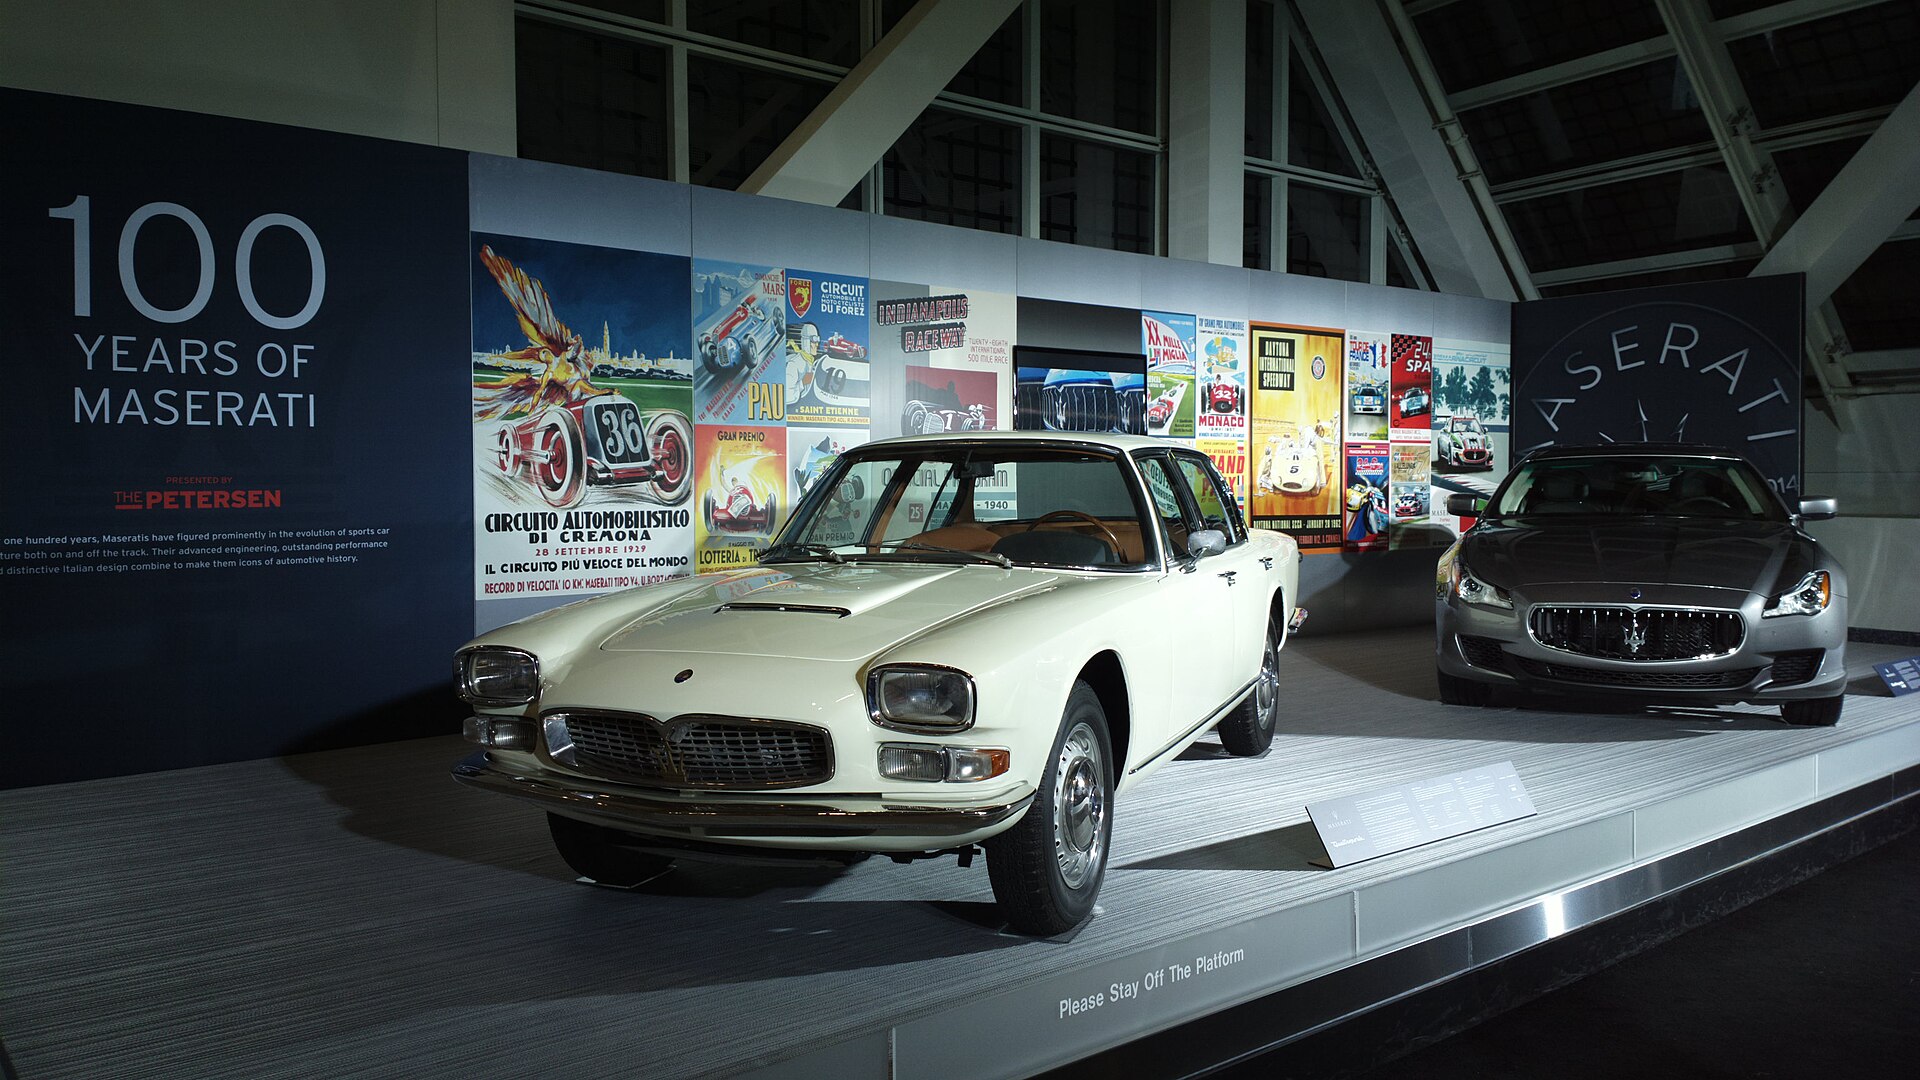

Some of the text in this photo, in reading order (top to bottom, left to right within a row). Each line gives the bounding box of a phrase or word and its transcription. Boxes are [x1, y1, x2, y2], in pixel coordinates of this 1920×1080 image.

[49, 195, 326, 330] 100
[762, 282, 785, 296] MARS
[790, 279, 810, 287] FOREZ
[820, 281, 864, 297] CIRCUIT
[821, 293, 857, 302] AUTOMOBILE
[821, 299, 864, 308] MOTOCYCLISTE
[821, 304, 865, 317] DU FOREZ
[878, 296, 968, 326] INDIANAPOLIS
[1144, 318, 1162, 346] XX
[1163, 334, 1181, 349] MILLE
[1265, 340, 1289, 357] DAYTONA
[74, 333, 314, 378] YEARS OF
[1163, 348, 1187, 361] MIGLIA
[1349, 350, 1370, 362] FRANCE
[1406, 359, 1431, 373] SPA
[823, 366, 847, 395] 19
[1263, 372, 1290, 388] SPEEDWAY
[74, 387, 314, 427] MASERATI
[748, 382, 784, 421] PAU
[799, 406, 859, 416] SAINT ETIENNE
[944, 413, 953, 430] 1
[1199, 416, 1244, 427] MONACO
[603, 409, 643, 457] 36
[717, 430, 765, 442] GRAN PREMIO
[1290, 465, 1300, 473] 5
[166, 476, 233, 485] PRESENTED BY
[113, 490, 281, 510] THE PETERSEN
[985, 501, 1008, 509] 1940
[485, 509, 690, 533] CIRCUITO AUTOMOBILISTICO
[4, 527, 390, 546] one hundred years, Maseratis have figured prominently in the evolution of sports car
[529, 530, 652, 544] DI CREMONA
[825, 532, 855, 542] PREMIO
[24, 550, 47, 560] both
[50, 551, 62, 559] on
[65, 550, 84, 558] and
[86, 549, 99, 558] off
[103, 548, 118, 558] the
[121, 547, 148, 557] track.
[151, 547, 176, 556] Their
[178, 545, 222, 556] advanced
[225, 543, 279, 555] engineering,
[282, 542, 333, 552] outstanding
[335, 540, 388, 551] performance
[535, 545, 647, 557] 28 SETTEMBRE 1929
[699, 550, 741, 565] LOTTERIA
[7, 565, 60, 575] distinctive
[63, 564, 93, 574] Italian
[96, 562, 128, 574] design
[131, 561, 171, 571] combine
[186, 560, 210, 569] make
[213, 559, 236, 568] them
[239, 558, 262, 567] icons
[265, 557, 274, 565] of
[276, 555, 324, 566] automotive
[327, 554, 358, 565] history.
[485, 556, 688, 574] IL CIRCUITO PIÙ VELOCE DEL MONDO
[485, 581, 515, 594] RECORD
[517, 581, 524, 592] DI
[586, 577, 613, 589] MASERATI
[614, 576, 629, 587] TIPO
[1059, 948, 1244, 1019] Please Stay Off The Platform
